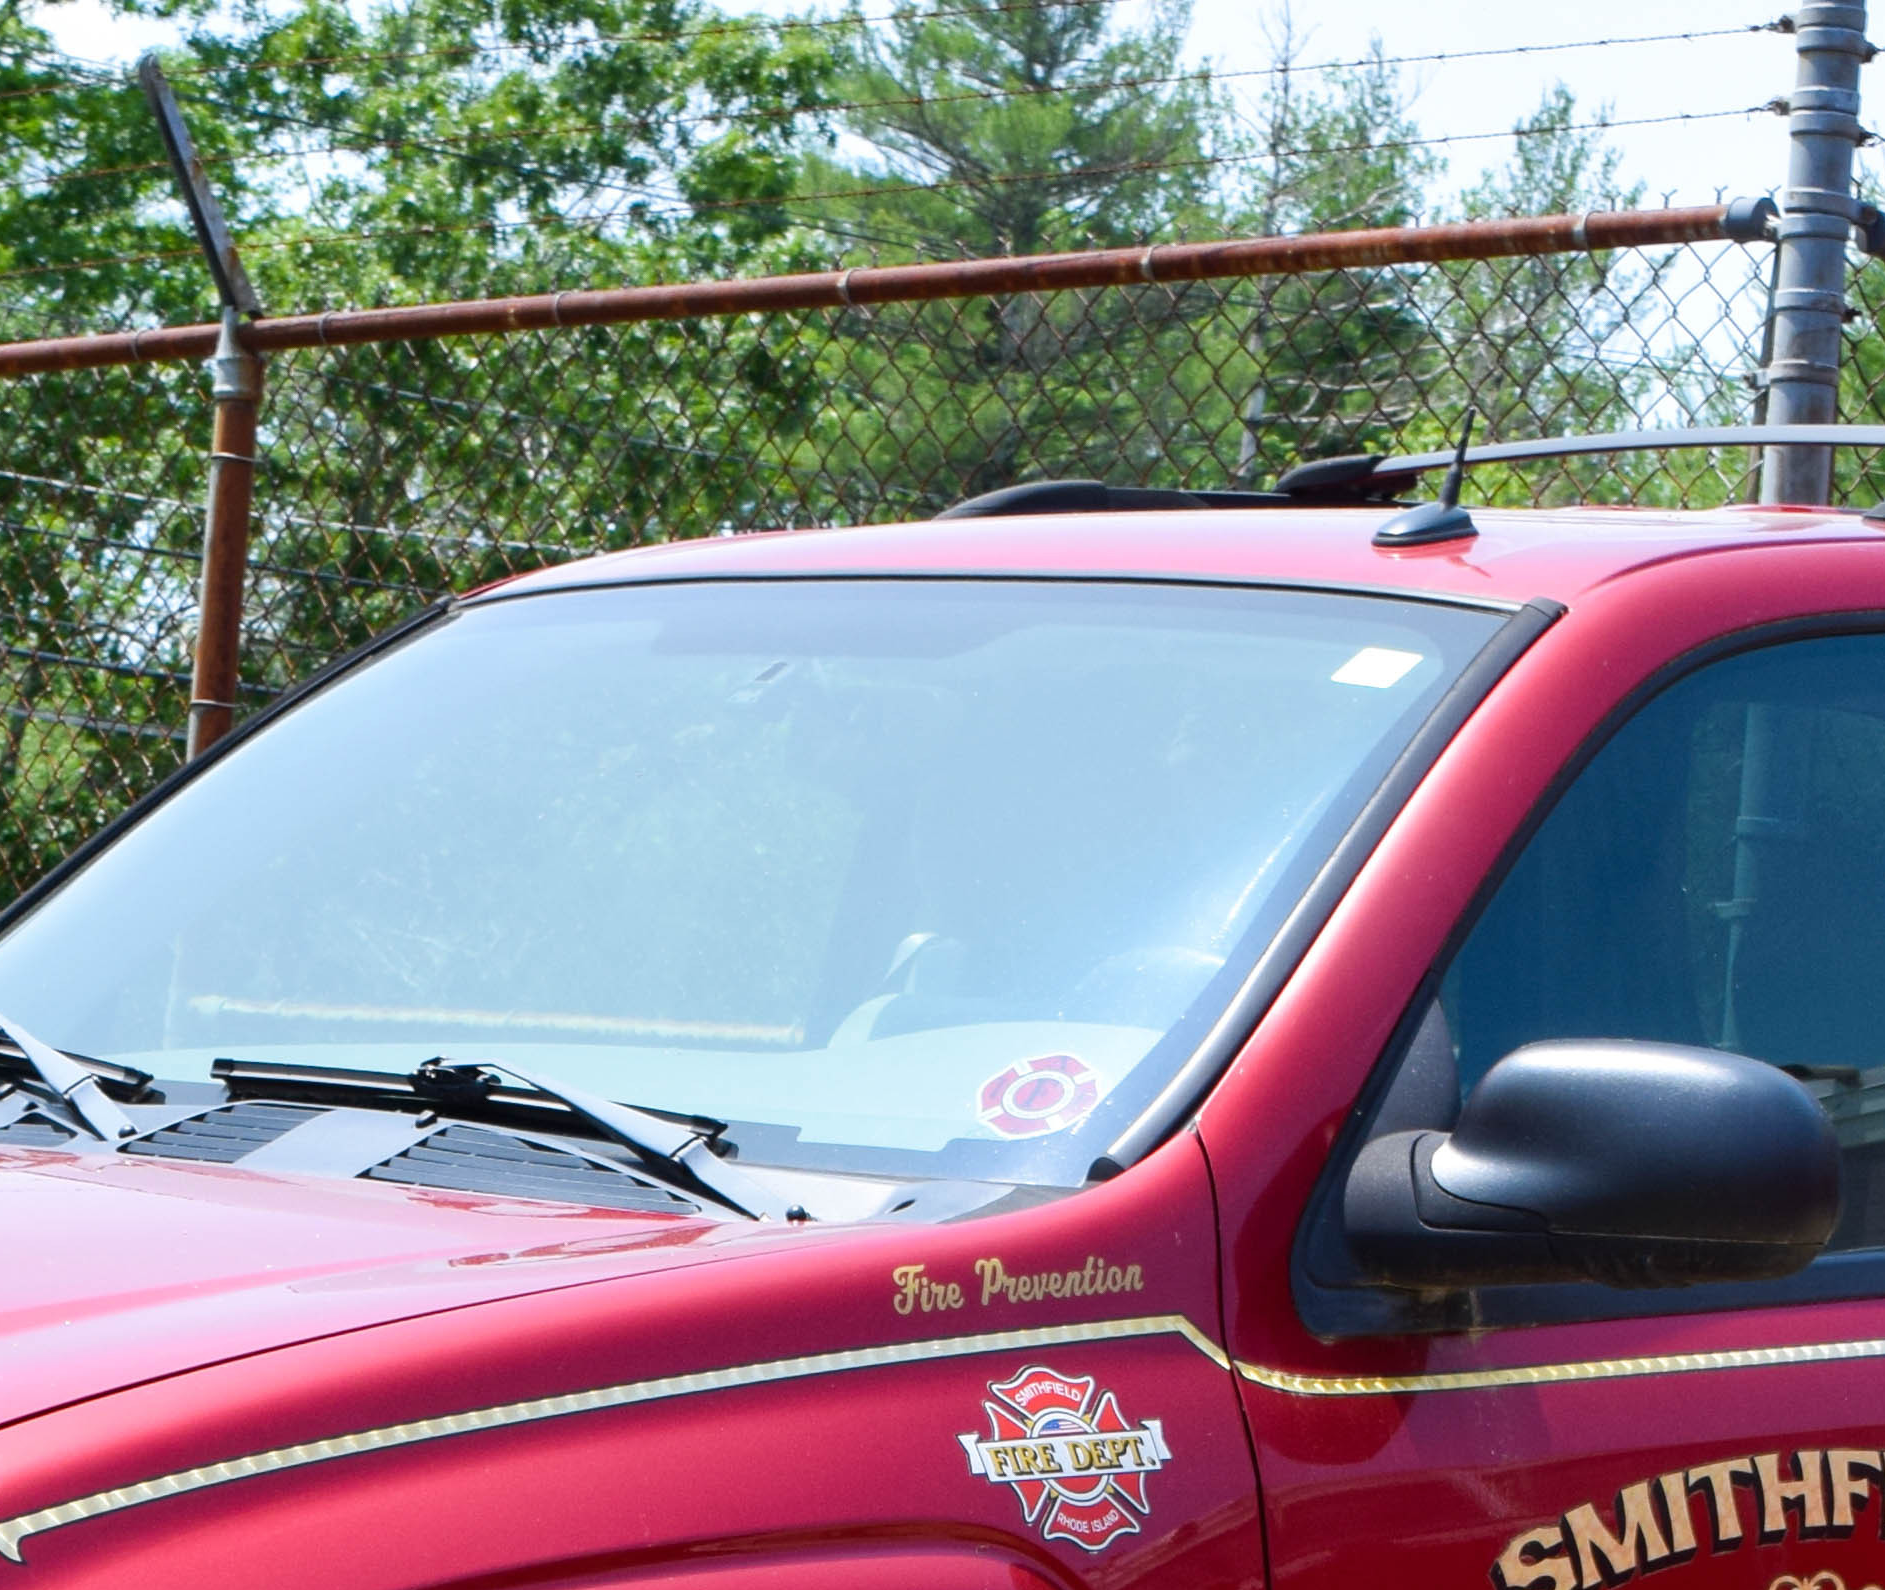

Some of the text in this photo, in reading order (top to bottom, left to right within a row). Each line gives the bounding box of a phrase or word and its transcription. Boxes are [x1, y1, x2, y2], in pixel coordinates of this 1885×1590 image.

[893, 1256, 1144, 1315] Fire Prevention
[1014, 1381, 1081, 1407] SMITHFIELD
[986, 1436, 1156, 1477] FIRE DEPT.
[1056, 1507, 1120, 1534] RHODE ISLAND
